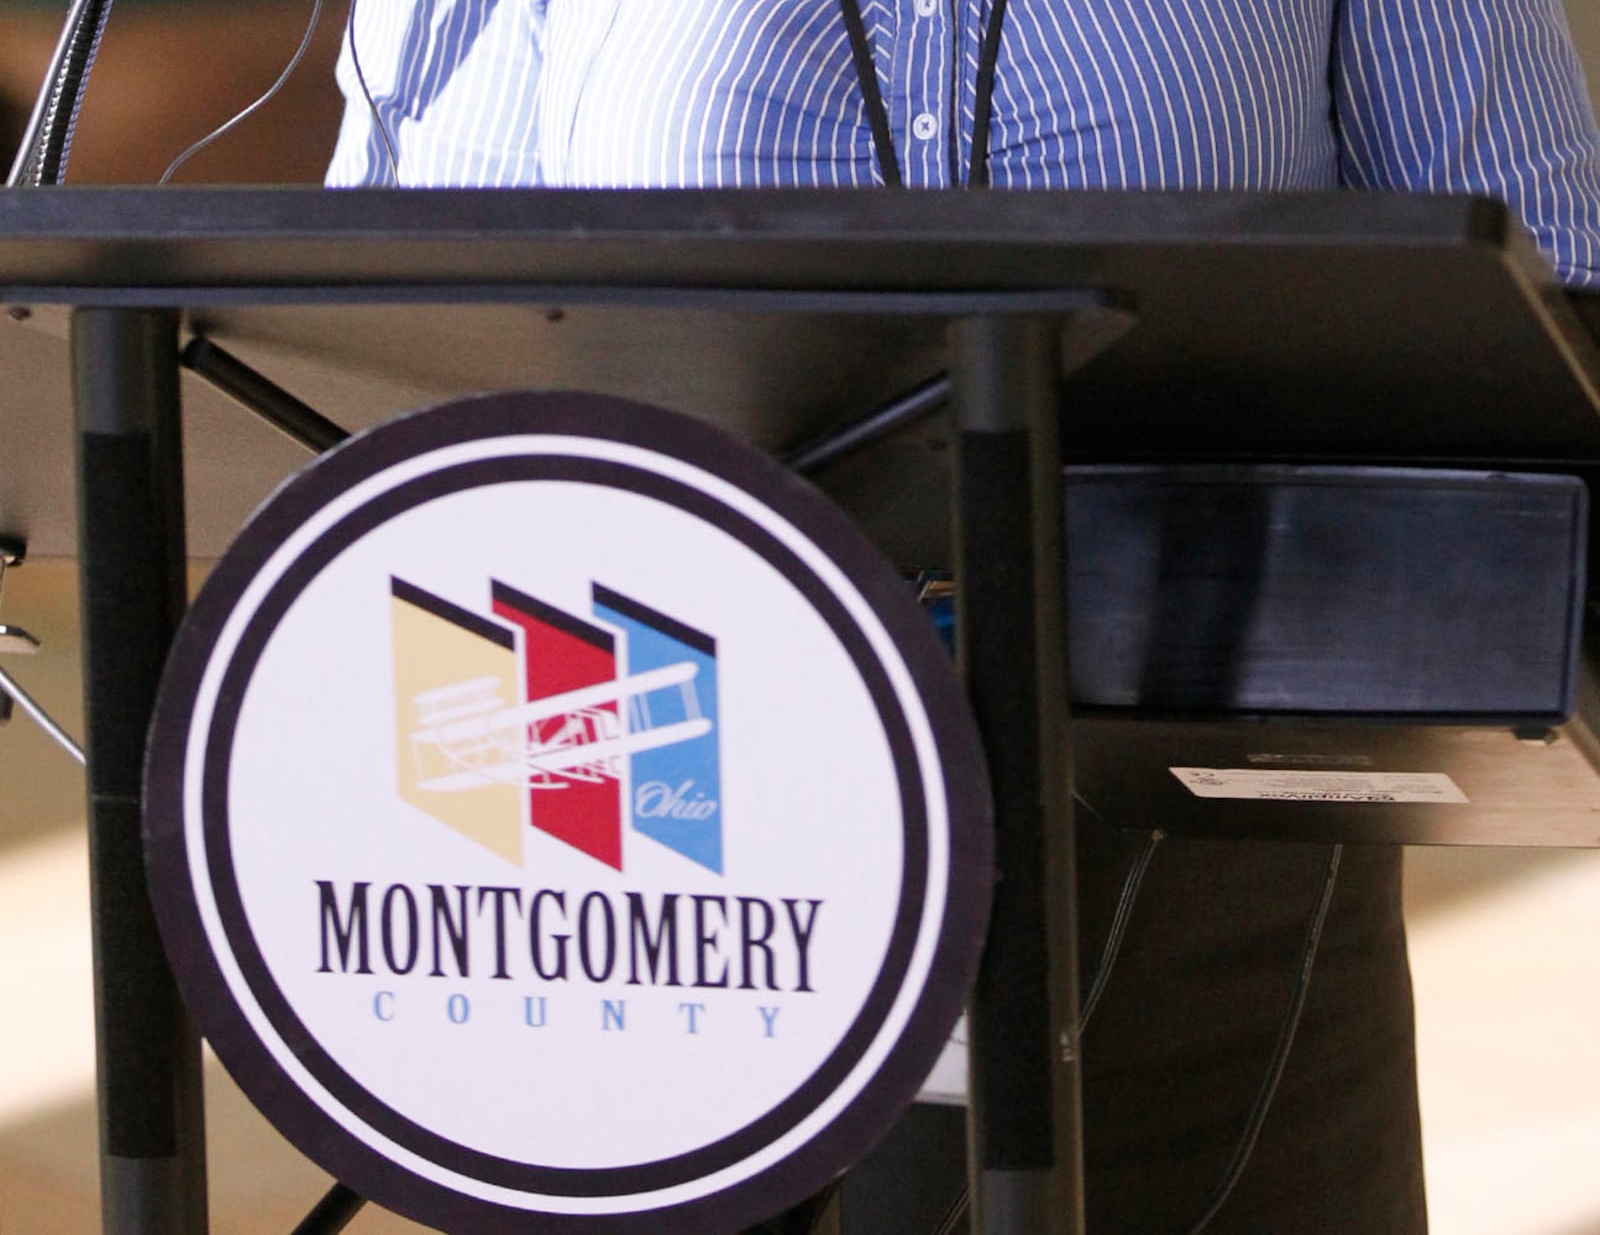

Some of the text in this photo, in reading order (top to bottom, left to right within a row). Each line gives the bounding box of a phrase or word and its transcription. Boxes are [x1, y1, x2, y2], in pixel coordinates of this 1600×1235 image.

[635, 779, 717, 820] Ohio
[316, 880, 824, 993] MONTGOMERY
[373, 991, 782, 1039] COUNTY
